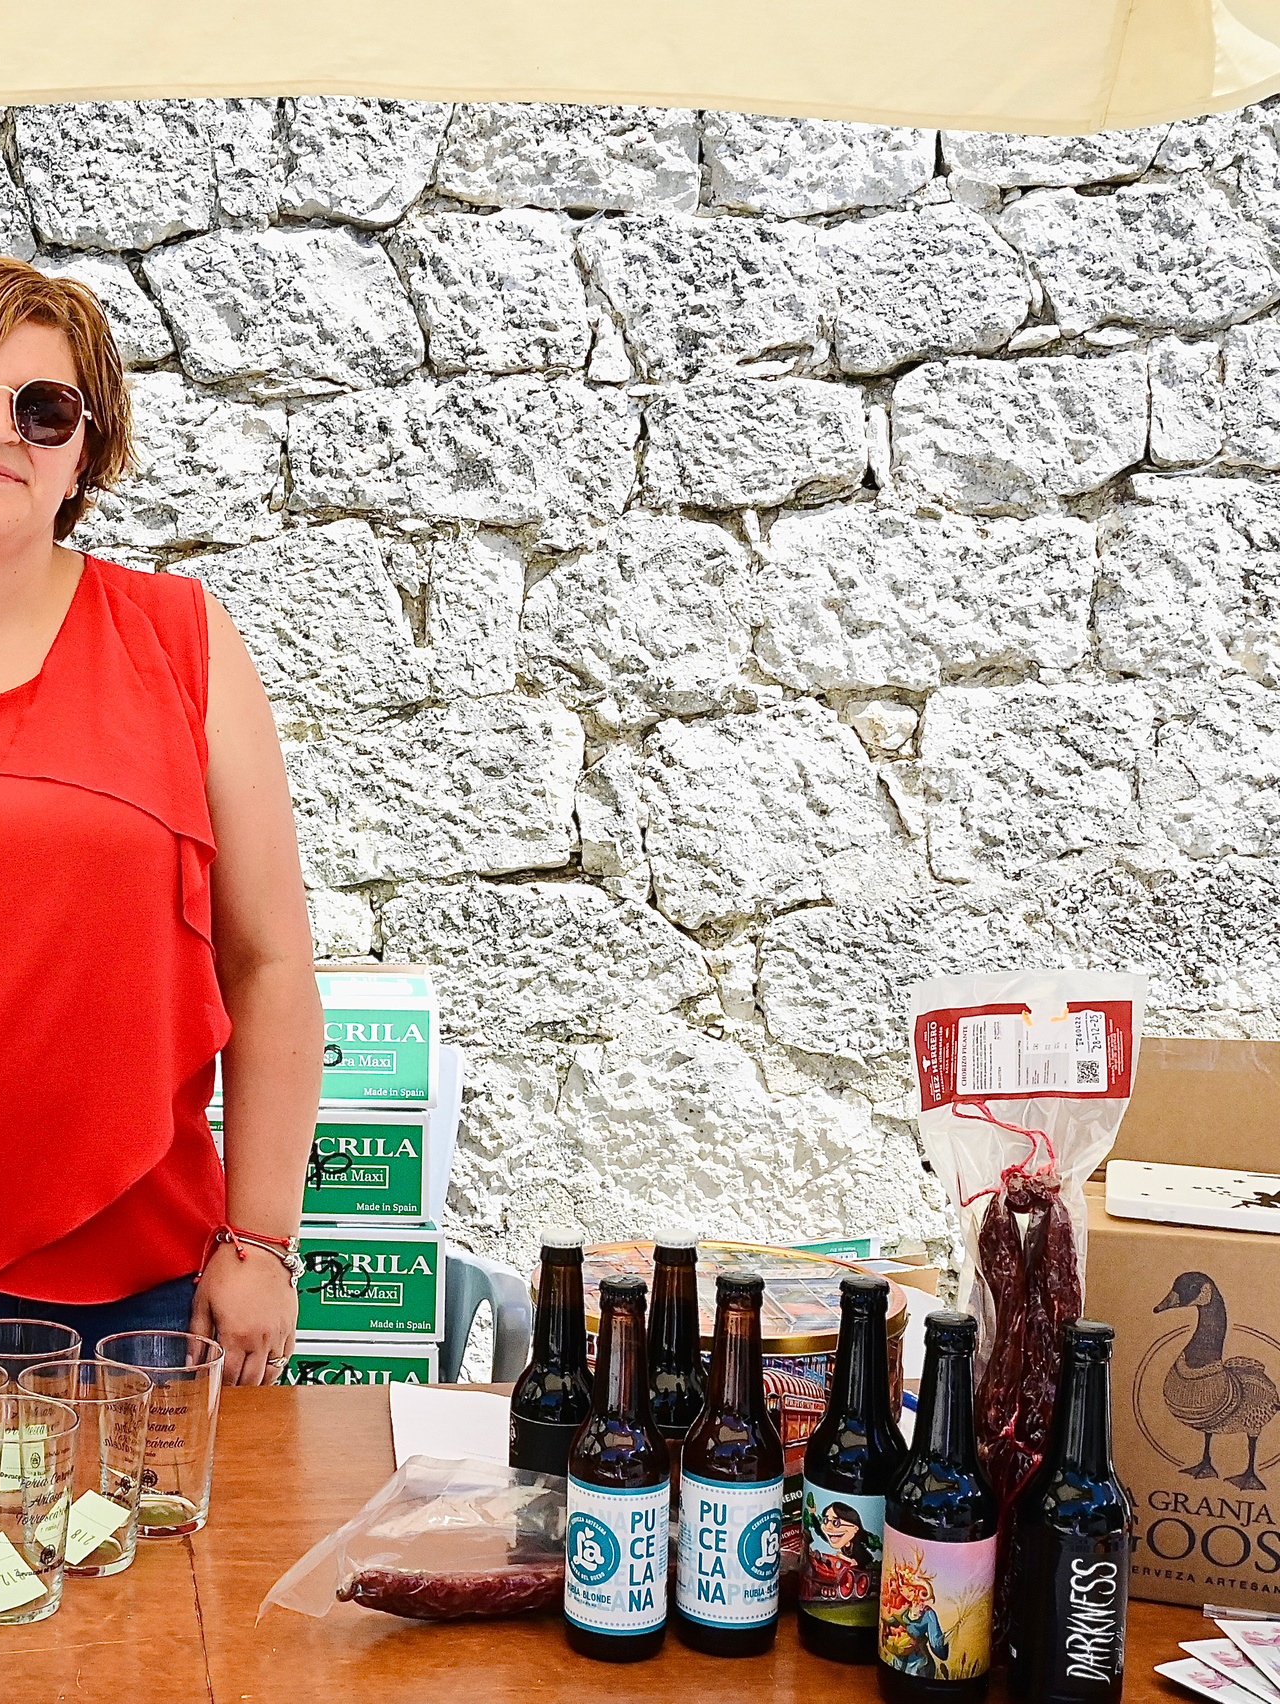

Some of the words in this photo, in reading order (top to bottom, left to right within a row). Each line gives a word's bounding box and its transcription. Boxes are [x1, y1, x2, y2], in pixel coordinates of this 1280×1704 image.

[323, 1022, 427, 1043] CRILA
[930, 1021, 939, 1073] HERRERO
[358, 1054, 391, 1068] Maxi
[363, 1088, 388, 1097] Made
[390, 1088, 399, 1097] in
[400, 1088, 425, 1098] Spain
[314, 1136, 419, 1158] CRILA
[351, 1169, 384, 1182] Maxi
[356, 1202, 380, 1211] Made
[382, 1202, 391, 1211] in
[392, 1203, 418, 1213] Spain
[298, 1252, 433, 1275] RILA
[365, 1286, 398, 1299] Maxi
[370, 1319, 394, 1329] Made
[396, 1320, 405, 1329] in
[406, 1320, 431, 1331] Spain
[148, 1423, 176, 1432] sana
[145, 1436, 186, 1449] cárcela
[699, 1499, 727, 1526] PU
[1148, 1490, 1277, 1527] GRANJA
[630, 1508, 656, 1534] PU
[751, 1515, 770, 1531] CERVEZA
[70, 1528, 96, 1546] 218
[629, 1534, 656, 1560] CE
[698, 1527, 727, 1553] CE
[1131, 1515, 1280, 1574] OOS
[628, 1561, 655, 1587] LA
[698, 1552, 726, 1580] LA
[1131, 1565, 1196, 1583] ERVEZA
[582, 1590, 612, 1605] BLONDE
[628, 1587, 655, 1613] NA
[697, 1578, 726, 1606] NA
[743, 1588, 765, 1599] RUBIA
[1066, 1558, 1118, 1685] DARKNESS
